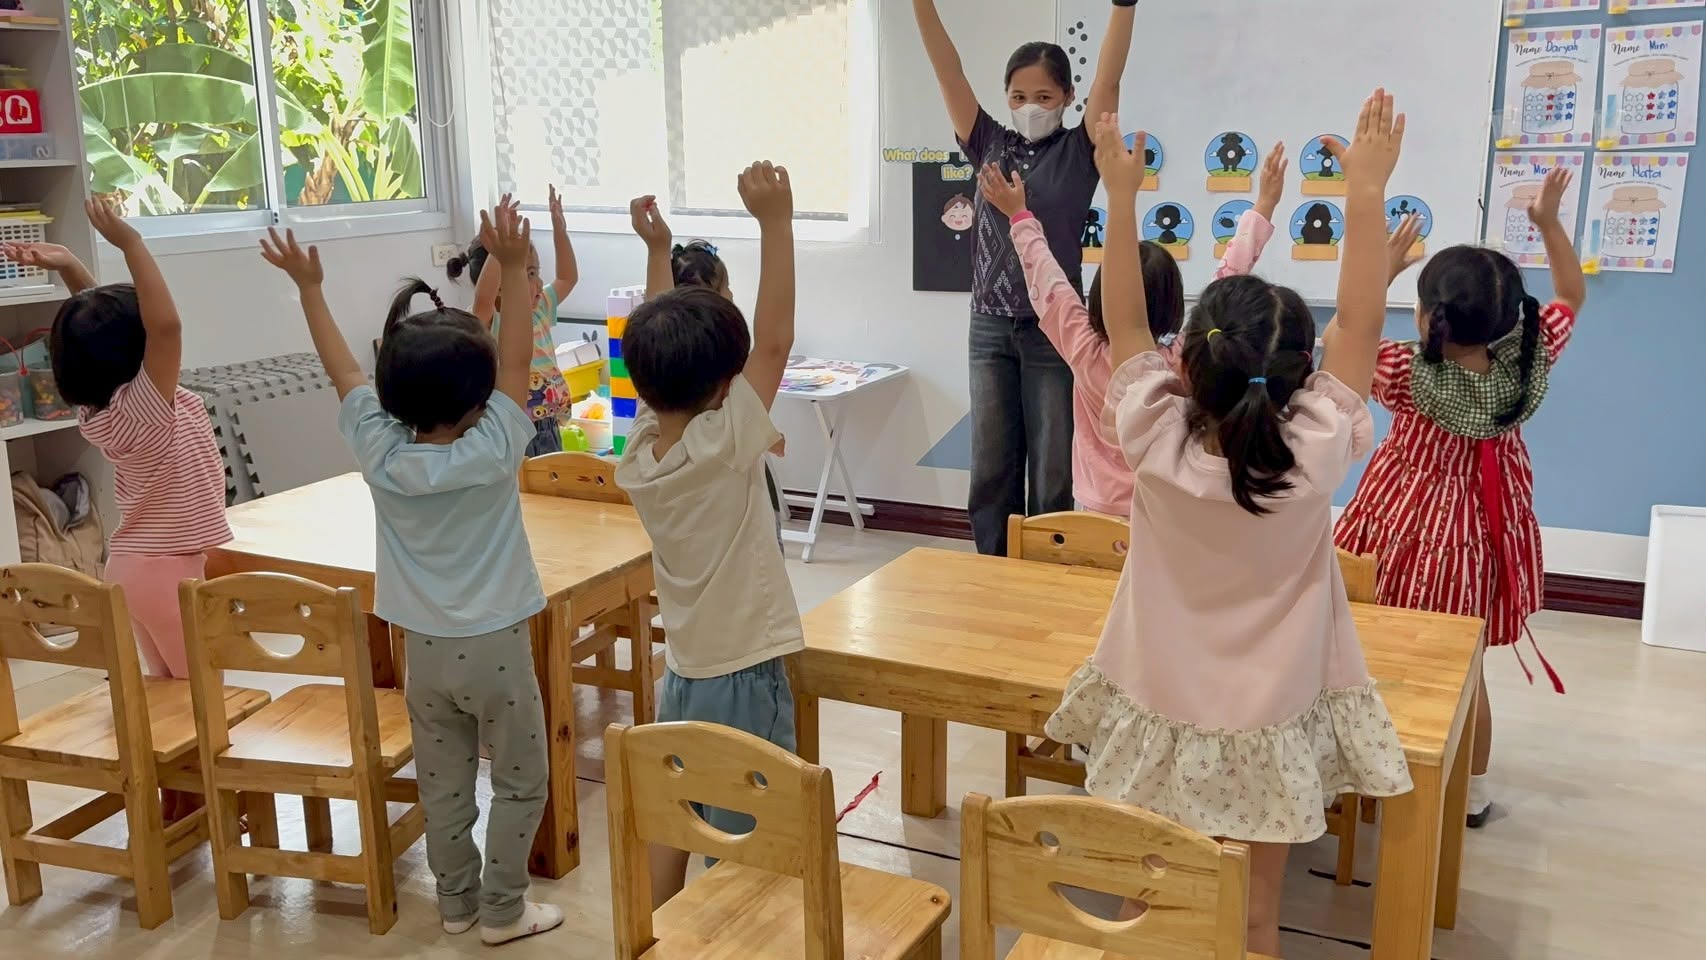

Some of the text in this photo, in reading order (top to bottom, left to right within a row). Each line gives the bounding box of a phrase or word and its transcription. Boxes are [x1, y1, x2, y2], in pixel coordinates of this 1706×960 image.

[1514, 43, 1542, 55] Name
[1612, 43, 1639, 54] Name
[883, 148, 917, 161] What
[919, 147, 949, 161] does
[942, 165, 973, 180] like?
[1499, 166, 1526, 177] Name
[1599, 163, 1661, 178] Name Nata
